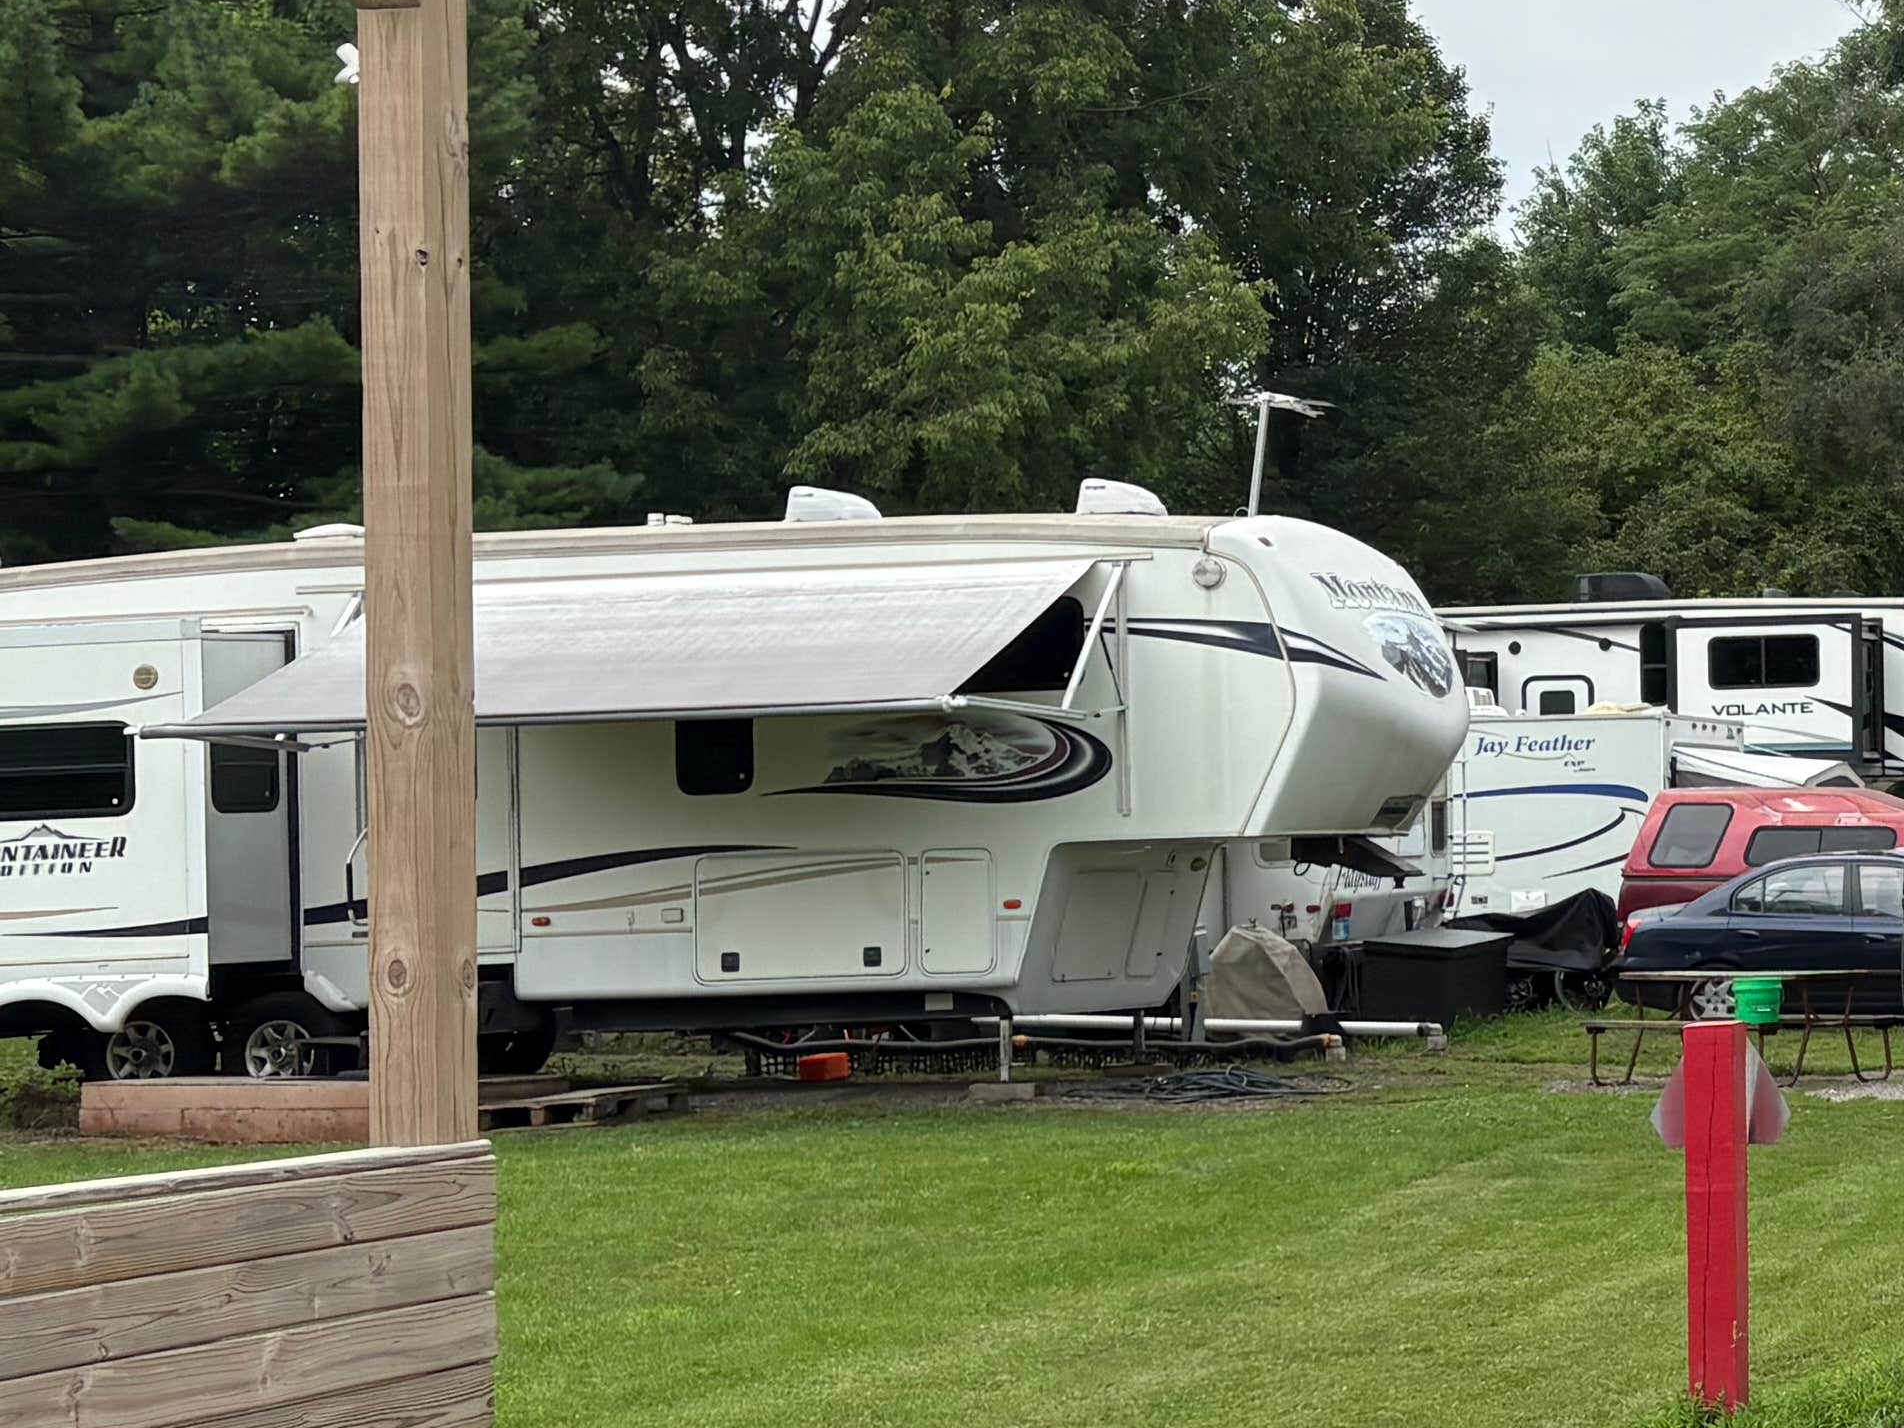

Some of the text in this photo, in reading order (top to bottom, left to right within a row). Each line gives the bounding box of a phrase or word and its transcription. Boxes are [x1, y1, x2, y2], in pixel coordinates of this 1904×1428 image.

[1712, 702, 1814, 716] VOLANTE
[1474, 734, 1596, 757] Jay Feather
